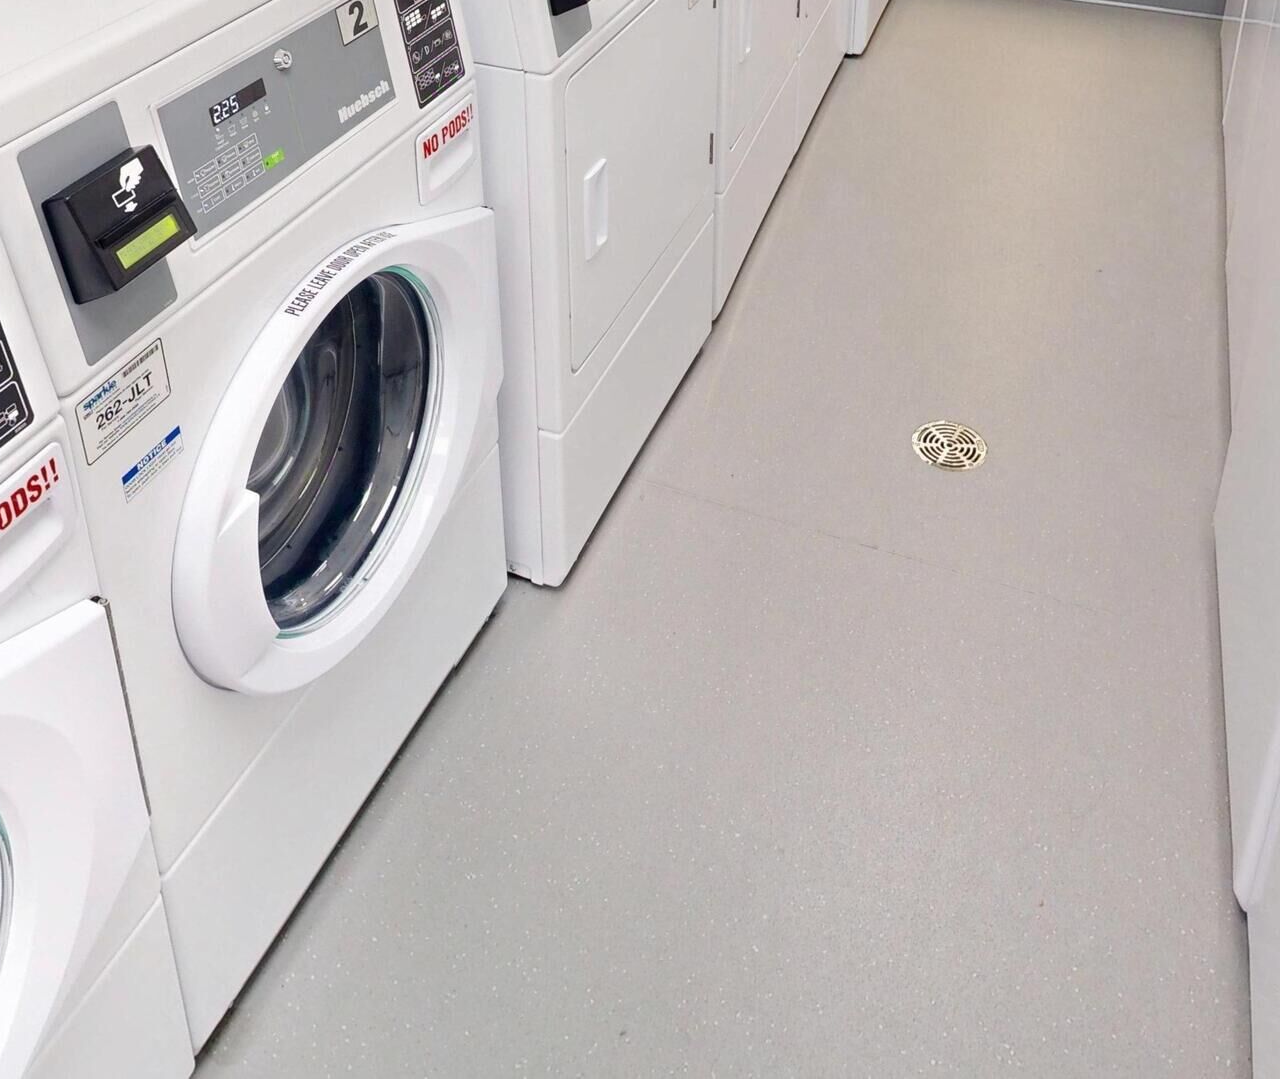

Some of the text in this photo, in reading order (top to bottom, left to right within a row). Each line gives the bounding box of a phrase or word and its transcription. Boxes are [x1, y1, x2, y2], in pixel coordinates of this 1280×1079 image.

[347, 0, 369, 35] 2
[337, 79, 390, 124] Huebsch
[422, 103, 474, 160] NO PODS!!
[284, 287, 319, 317] PLEASE
[307, 269, 337, 290] LEAVE
[326, 255, 354, 272] DOOR
[343, 244, 367, 258] OPEN
[83, 379, 117, 411] sparkle
[96, 371, 152, 430] 262-JLT
[136, 439, 168, 470] NOTICE
